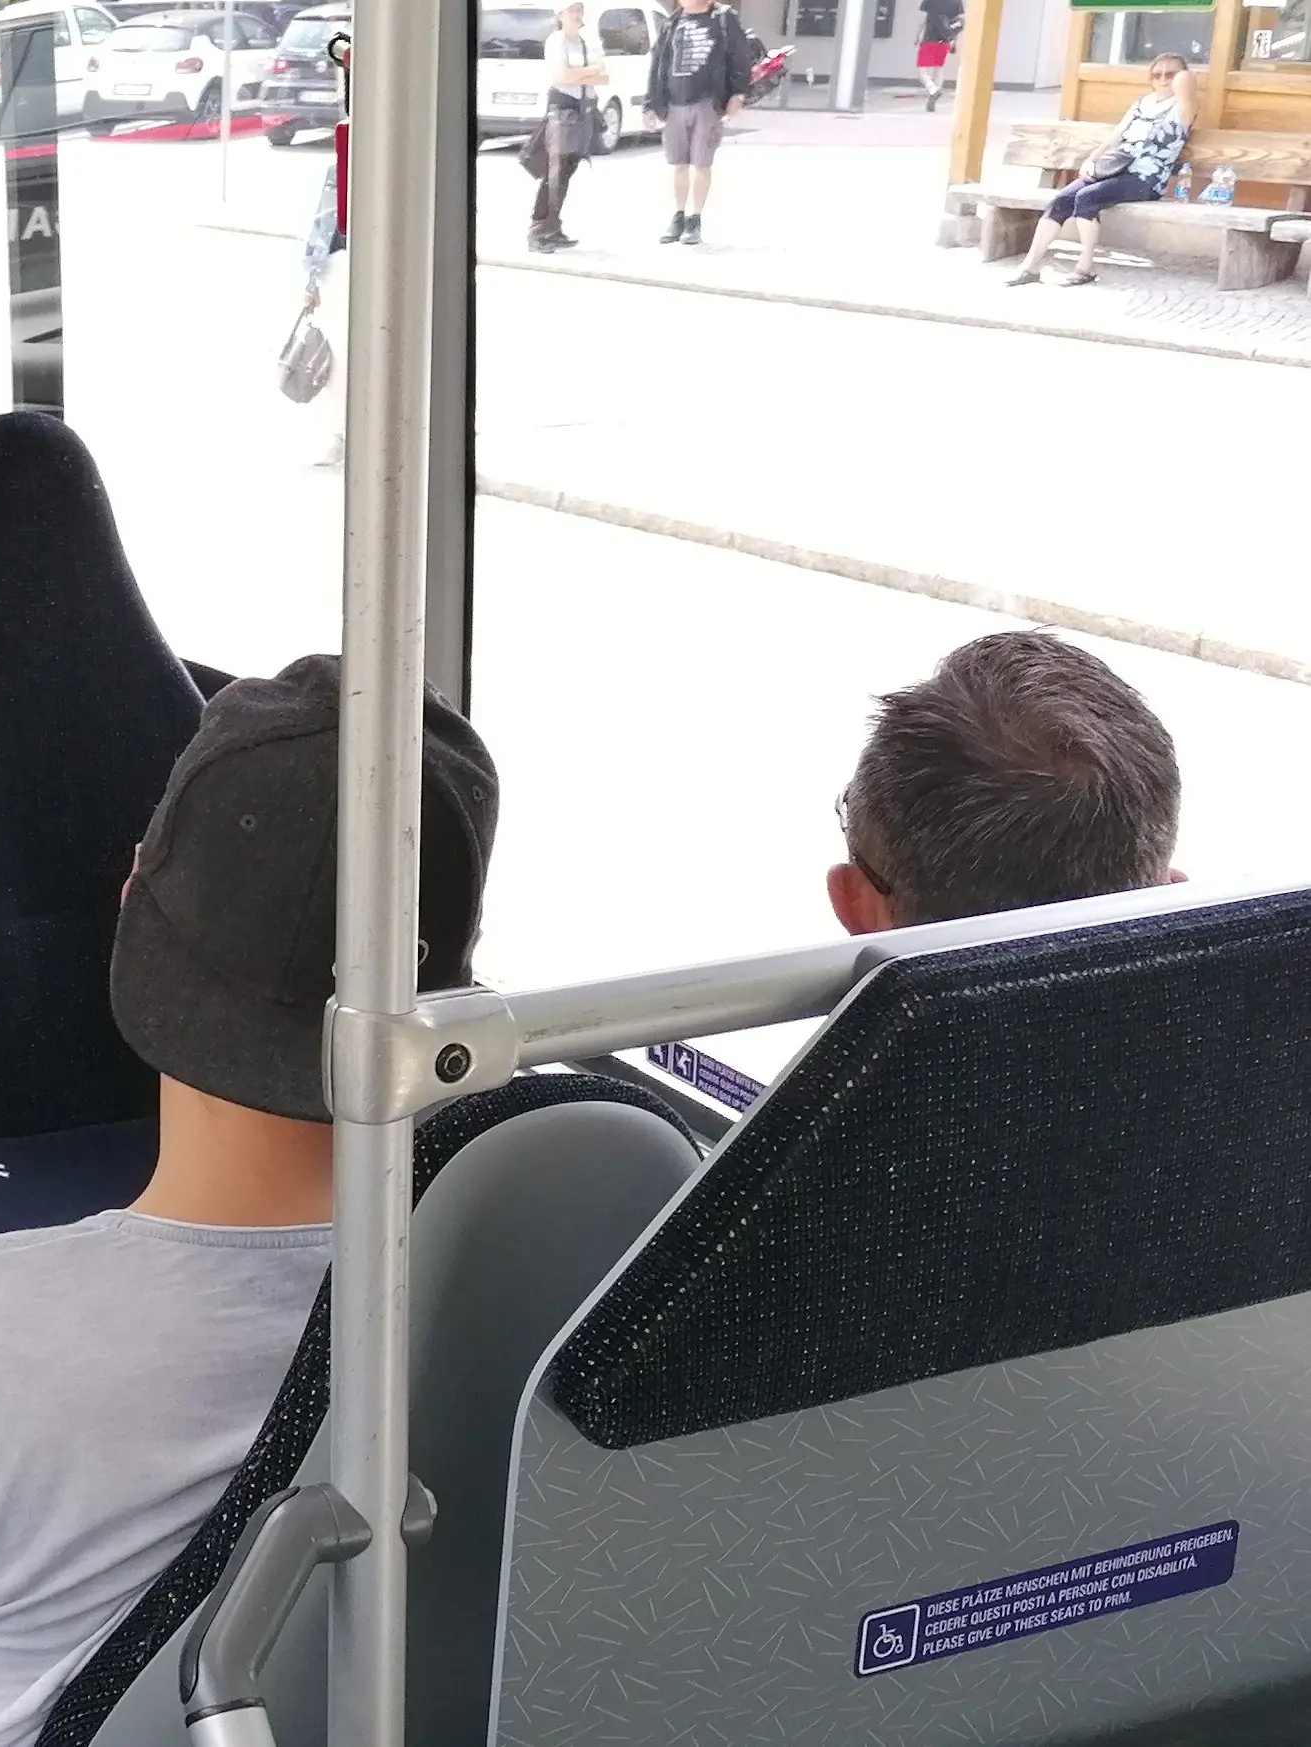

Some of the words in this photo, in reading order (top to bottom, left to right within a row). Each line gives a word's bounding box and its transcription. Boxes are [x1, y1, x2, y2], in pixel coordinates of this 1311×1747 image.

[925, 1614, 969, 1637] CEDERE
[970, 1604, 1011, 1625] QUESTI
[1013, 1596, 1046, 1613] POSTI
[1047, 1593, 1056, 1606] A
[1058, 1578, 1109, 1603] PERSONE
[1111, 1572, 1135, 1588] CON
[927, 1598, 960, 1618] DIESE
[962, 1587, 1003, 1609] PLÄTZE
[1005, 1572, 1069, 1597] MENSCHEN
[1071, 1564, 1093, 1581] MIT
[1094, 1544, 1172, 1575] BEHINDERUNG
[1174, 1528, 1234, 1555] FREIGEBEN.
[922, 1634, 965, 1656] PLEASE
[967, 1626, 993, 1645] GIVE
[995, 1622, 1012, 1637] UP
[1014, 1611, 1049, 1632] THESE
[1050, 1602, 1086, 1624] SEATS
[1088, 1598, 1102, 1612] TO
[1104, 1590, 1132, 1608] PRM.
